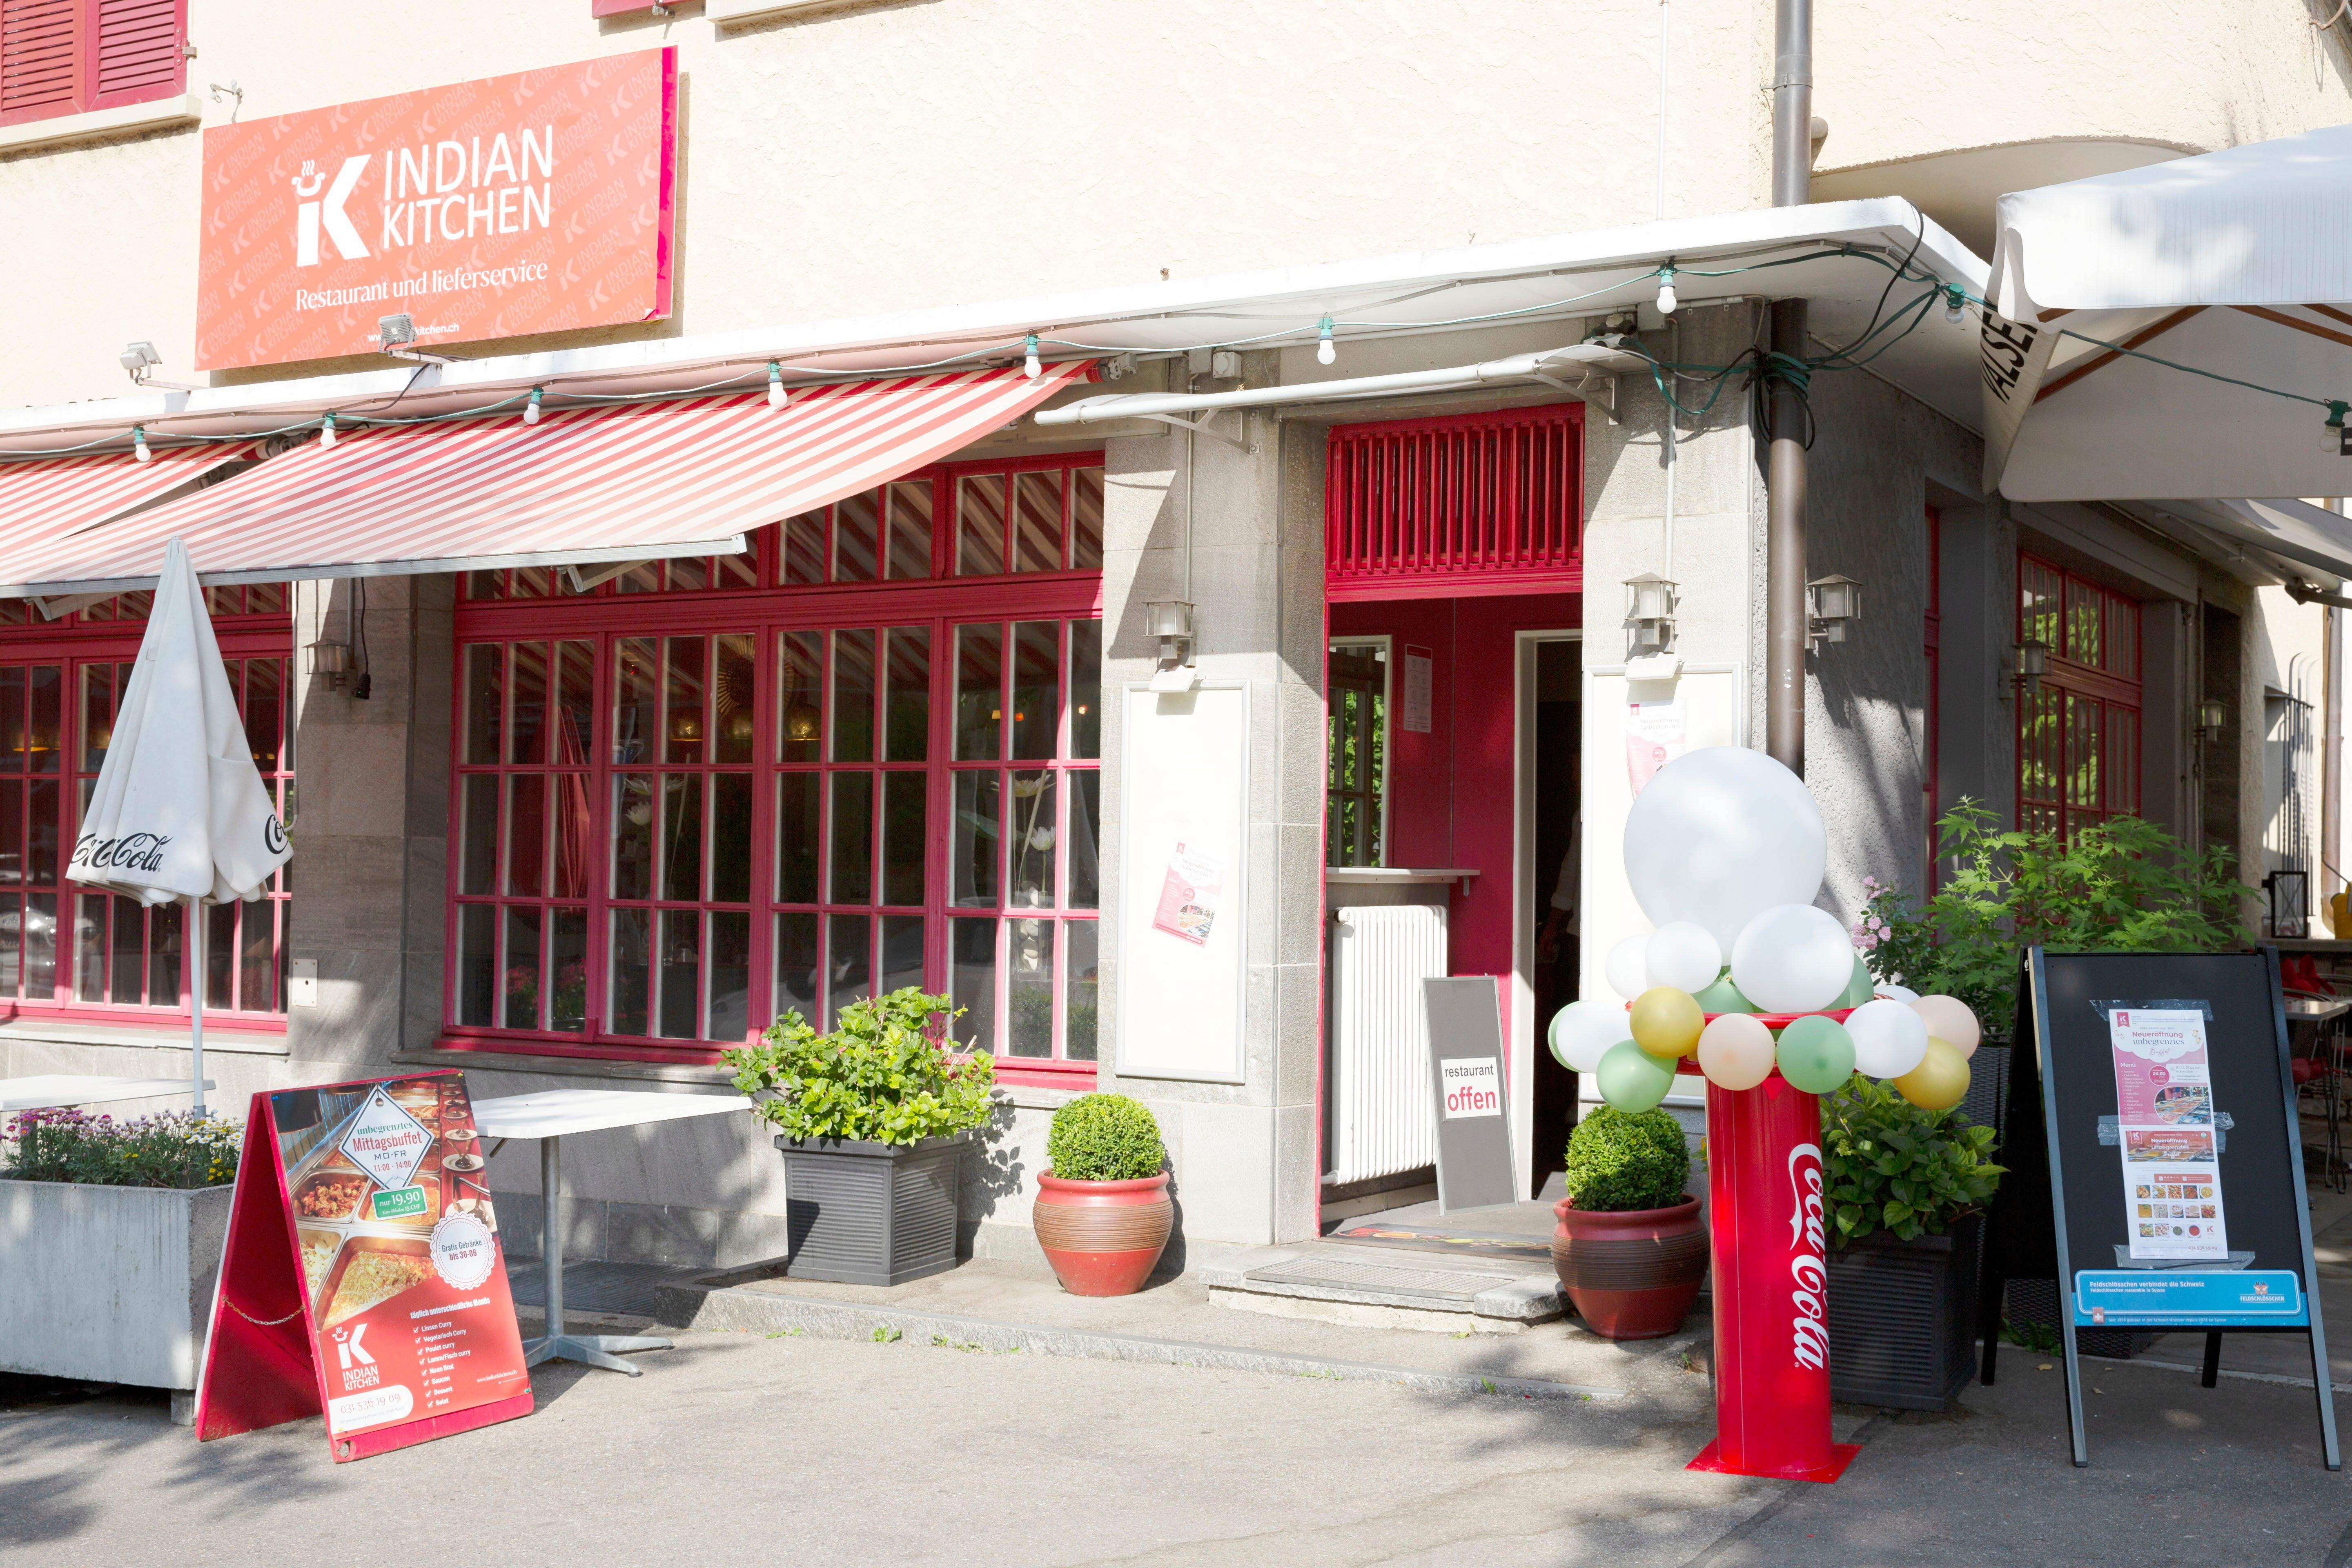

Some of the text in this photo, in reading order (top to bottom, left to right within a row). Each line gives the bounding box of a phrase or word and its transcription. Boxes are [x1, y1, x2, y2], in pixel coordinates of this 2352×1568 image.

[383, 125, 552, 200] INDIAN
[383, 182, 550, 249] KITCHEN
[296, 259, 548, 312] Restaurant und lieferservice
[2133, 1038, 2185, 1046] unbegrenztes
[1445, 1063, 1494, 1078] restaurant
[1448, 1086, 1496, 1112] offen
[357, 1122, 413, 1135] unbegrenztes
[352, 1131, 423, 1152] Mittagsbuffet
[374, 1150, 407, 1160] MO-FR
[374, 1163, 390, 1172] 11:00
[395, 1160, 412, 1169] 14:00
[391, 1191, 420, 1206] 19.90
[441, 1239, 482, 1252] Gratis Getränke
[459, 1249, 477, 1259] 30-06
[1788, 1143, 1829, 1370] Coca-Cola
[410, 1297, 490, 1319] täglich unterschiedliche Menüs
[421, 1323, 438, 1332] Linsen
[423, 1331, 452, 1343] Vegetarisch
[425, 1344, 442, 1353] Poulet
[428, 1352, 458, 1364] Lamm/Fisch
[343, 1365, 379, 1383] INDIAN
[443, 1363, 454, 1372] Brot
[344, 1375, 380, 1392] KITCHEN
[431, 1376, 450, 1385] Saucen
[433, 1386, 453, 1396] Dessert
[341, 1393, 400, 1414] 031 536 19 09
[435, 1397, 449, 1406] Salat
